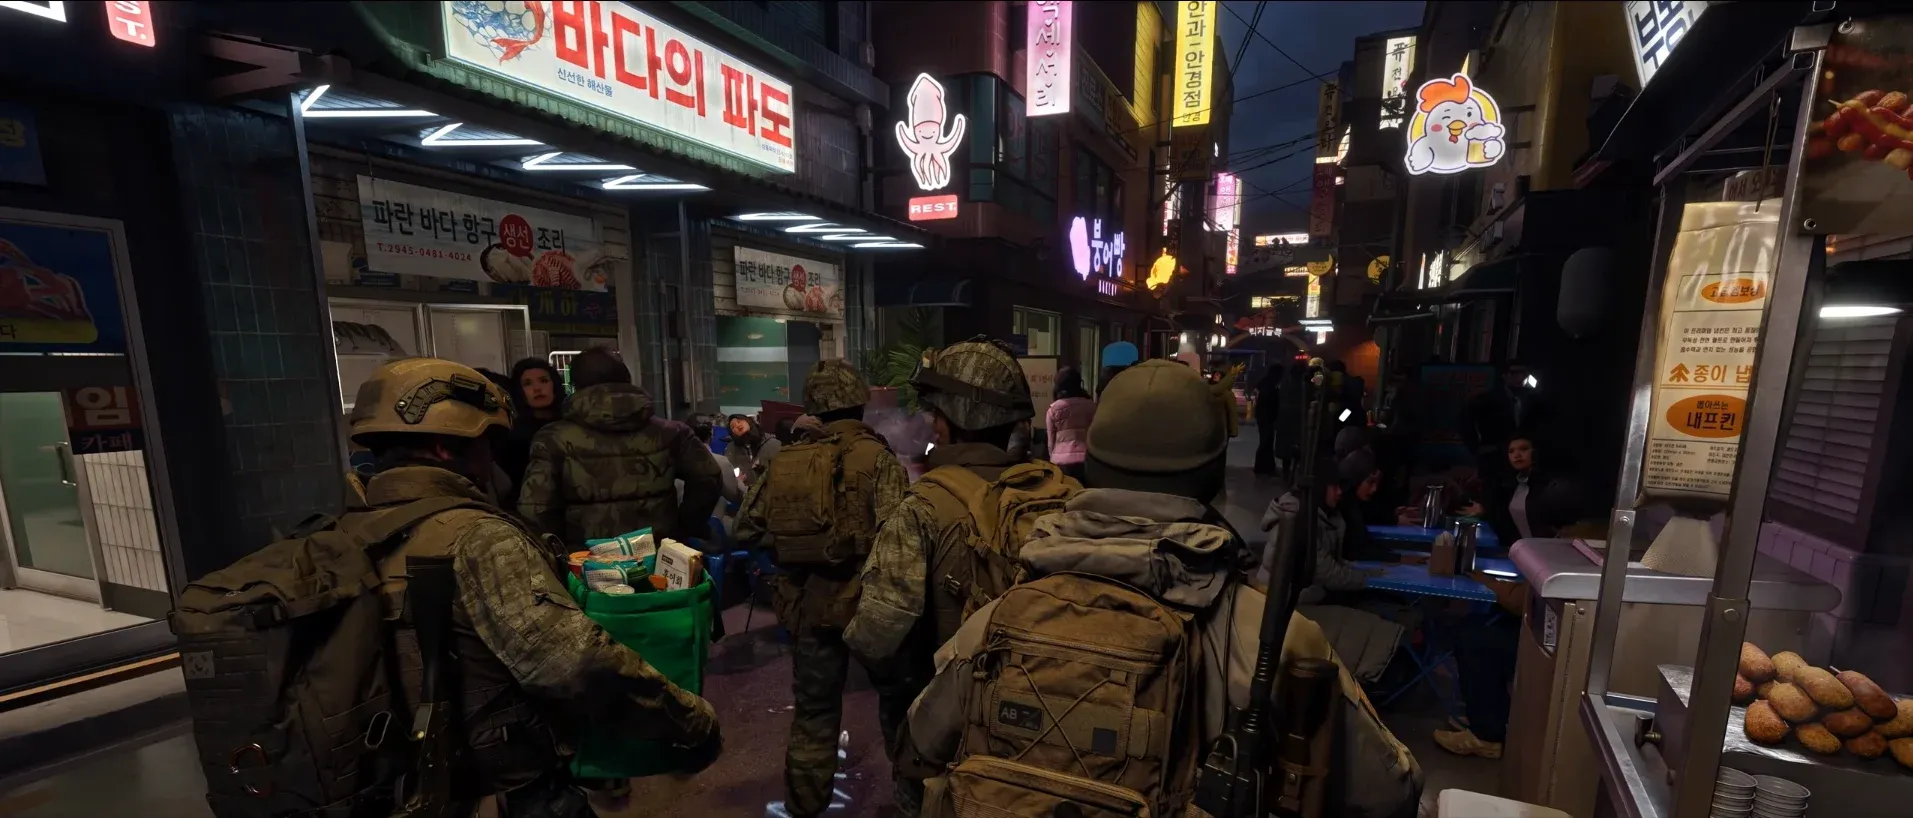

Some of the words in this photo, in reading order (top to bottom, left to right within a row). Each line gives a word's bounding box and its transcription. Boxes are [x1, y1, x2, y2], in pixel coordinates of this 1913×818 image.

[553, 0, 706, 118] 바다의
[720, 63, 793, 149] 파도
[557, 66, 586, 89] 신선한
[586, 79, 614, 99] 해산물
[372, 199, 414, 236] 파란
[420, 207, 458, 241] 바다
[463, 213, 497, 246] 항구
[502, 223, 531, 250] 생선
[537, 227, 566, 253] 조리
[377, 242, 472, 262] T.2945-0481-4024
[1091, 218, 1126, 278] 붕어빵
[740, 260, 757, 282] 파란
[758, 263, 775, 284] 바다
[776, 265, 790, 286] 항구
[808, 271, 821, 287] 조리
[1693, 364, 1727, 383] 종이
[62, 386, 133, 427] 임
[1687, 412, 1736, 430] 내프킨
[1000, 705, 1018, 720] AB
